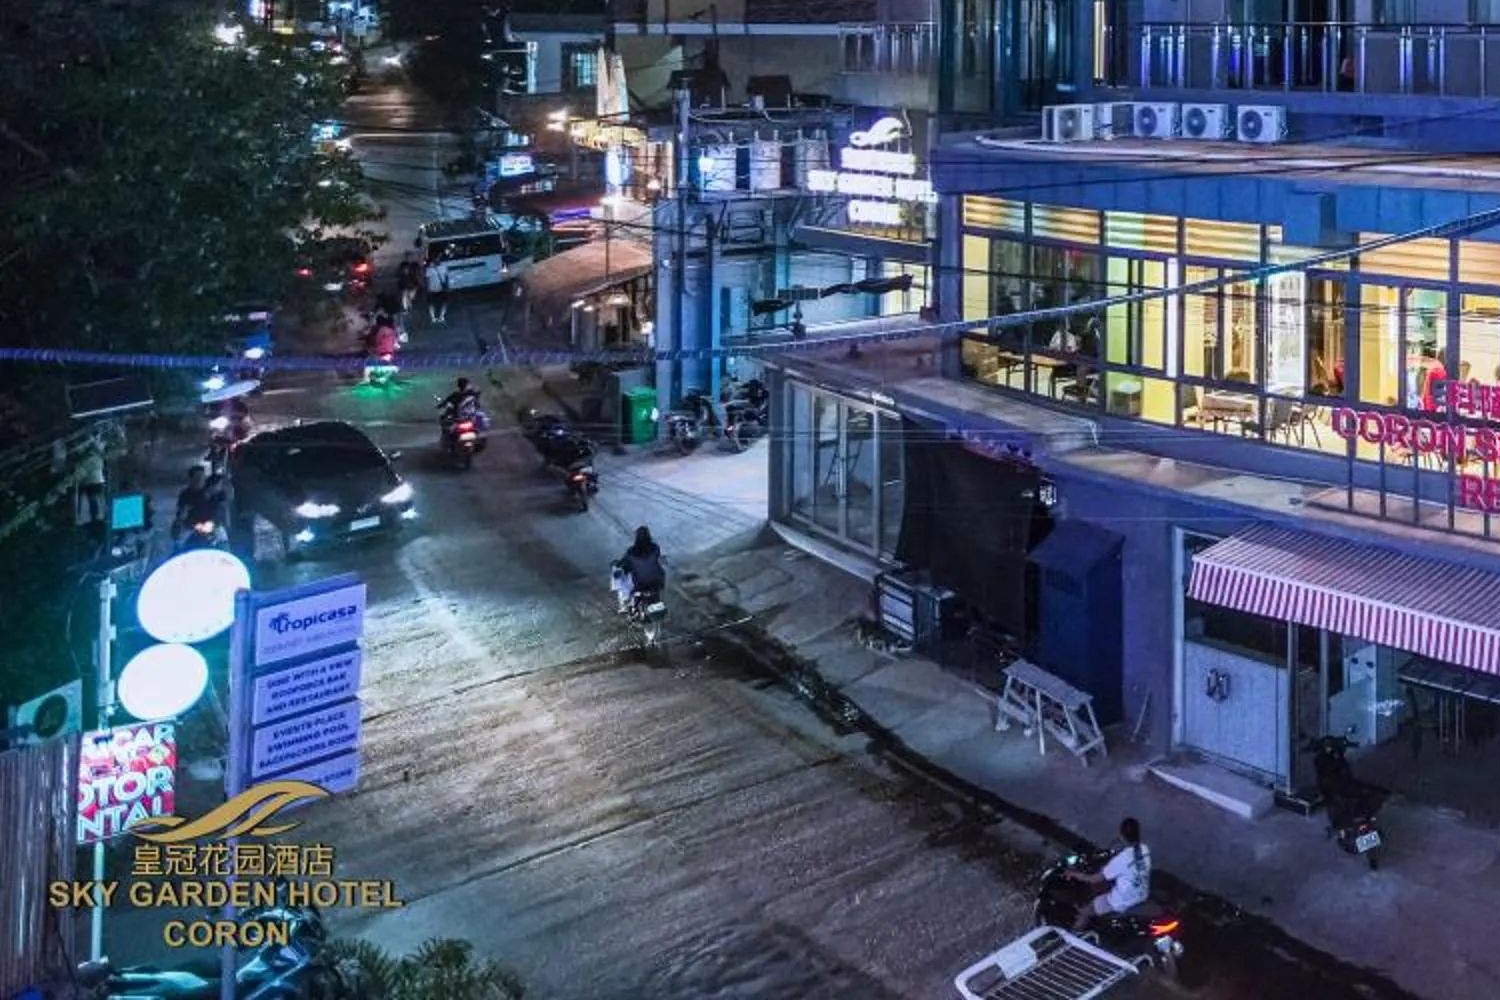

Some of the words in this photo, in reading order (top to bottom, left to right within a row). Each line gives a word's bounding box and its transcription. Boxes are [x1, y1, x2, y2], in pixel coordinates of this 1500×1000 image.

[1332, 407, 1467, 464] CORON
[79, 765, 173, 811] OTOR
[78, 796, 172, 843] NTAL
